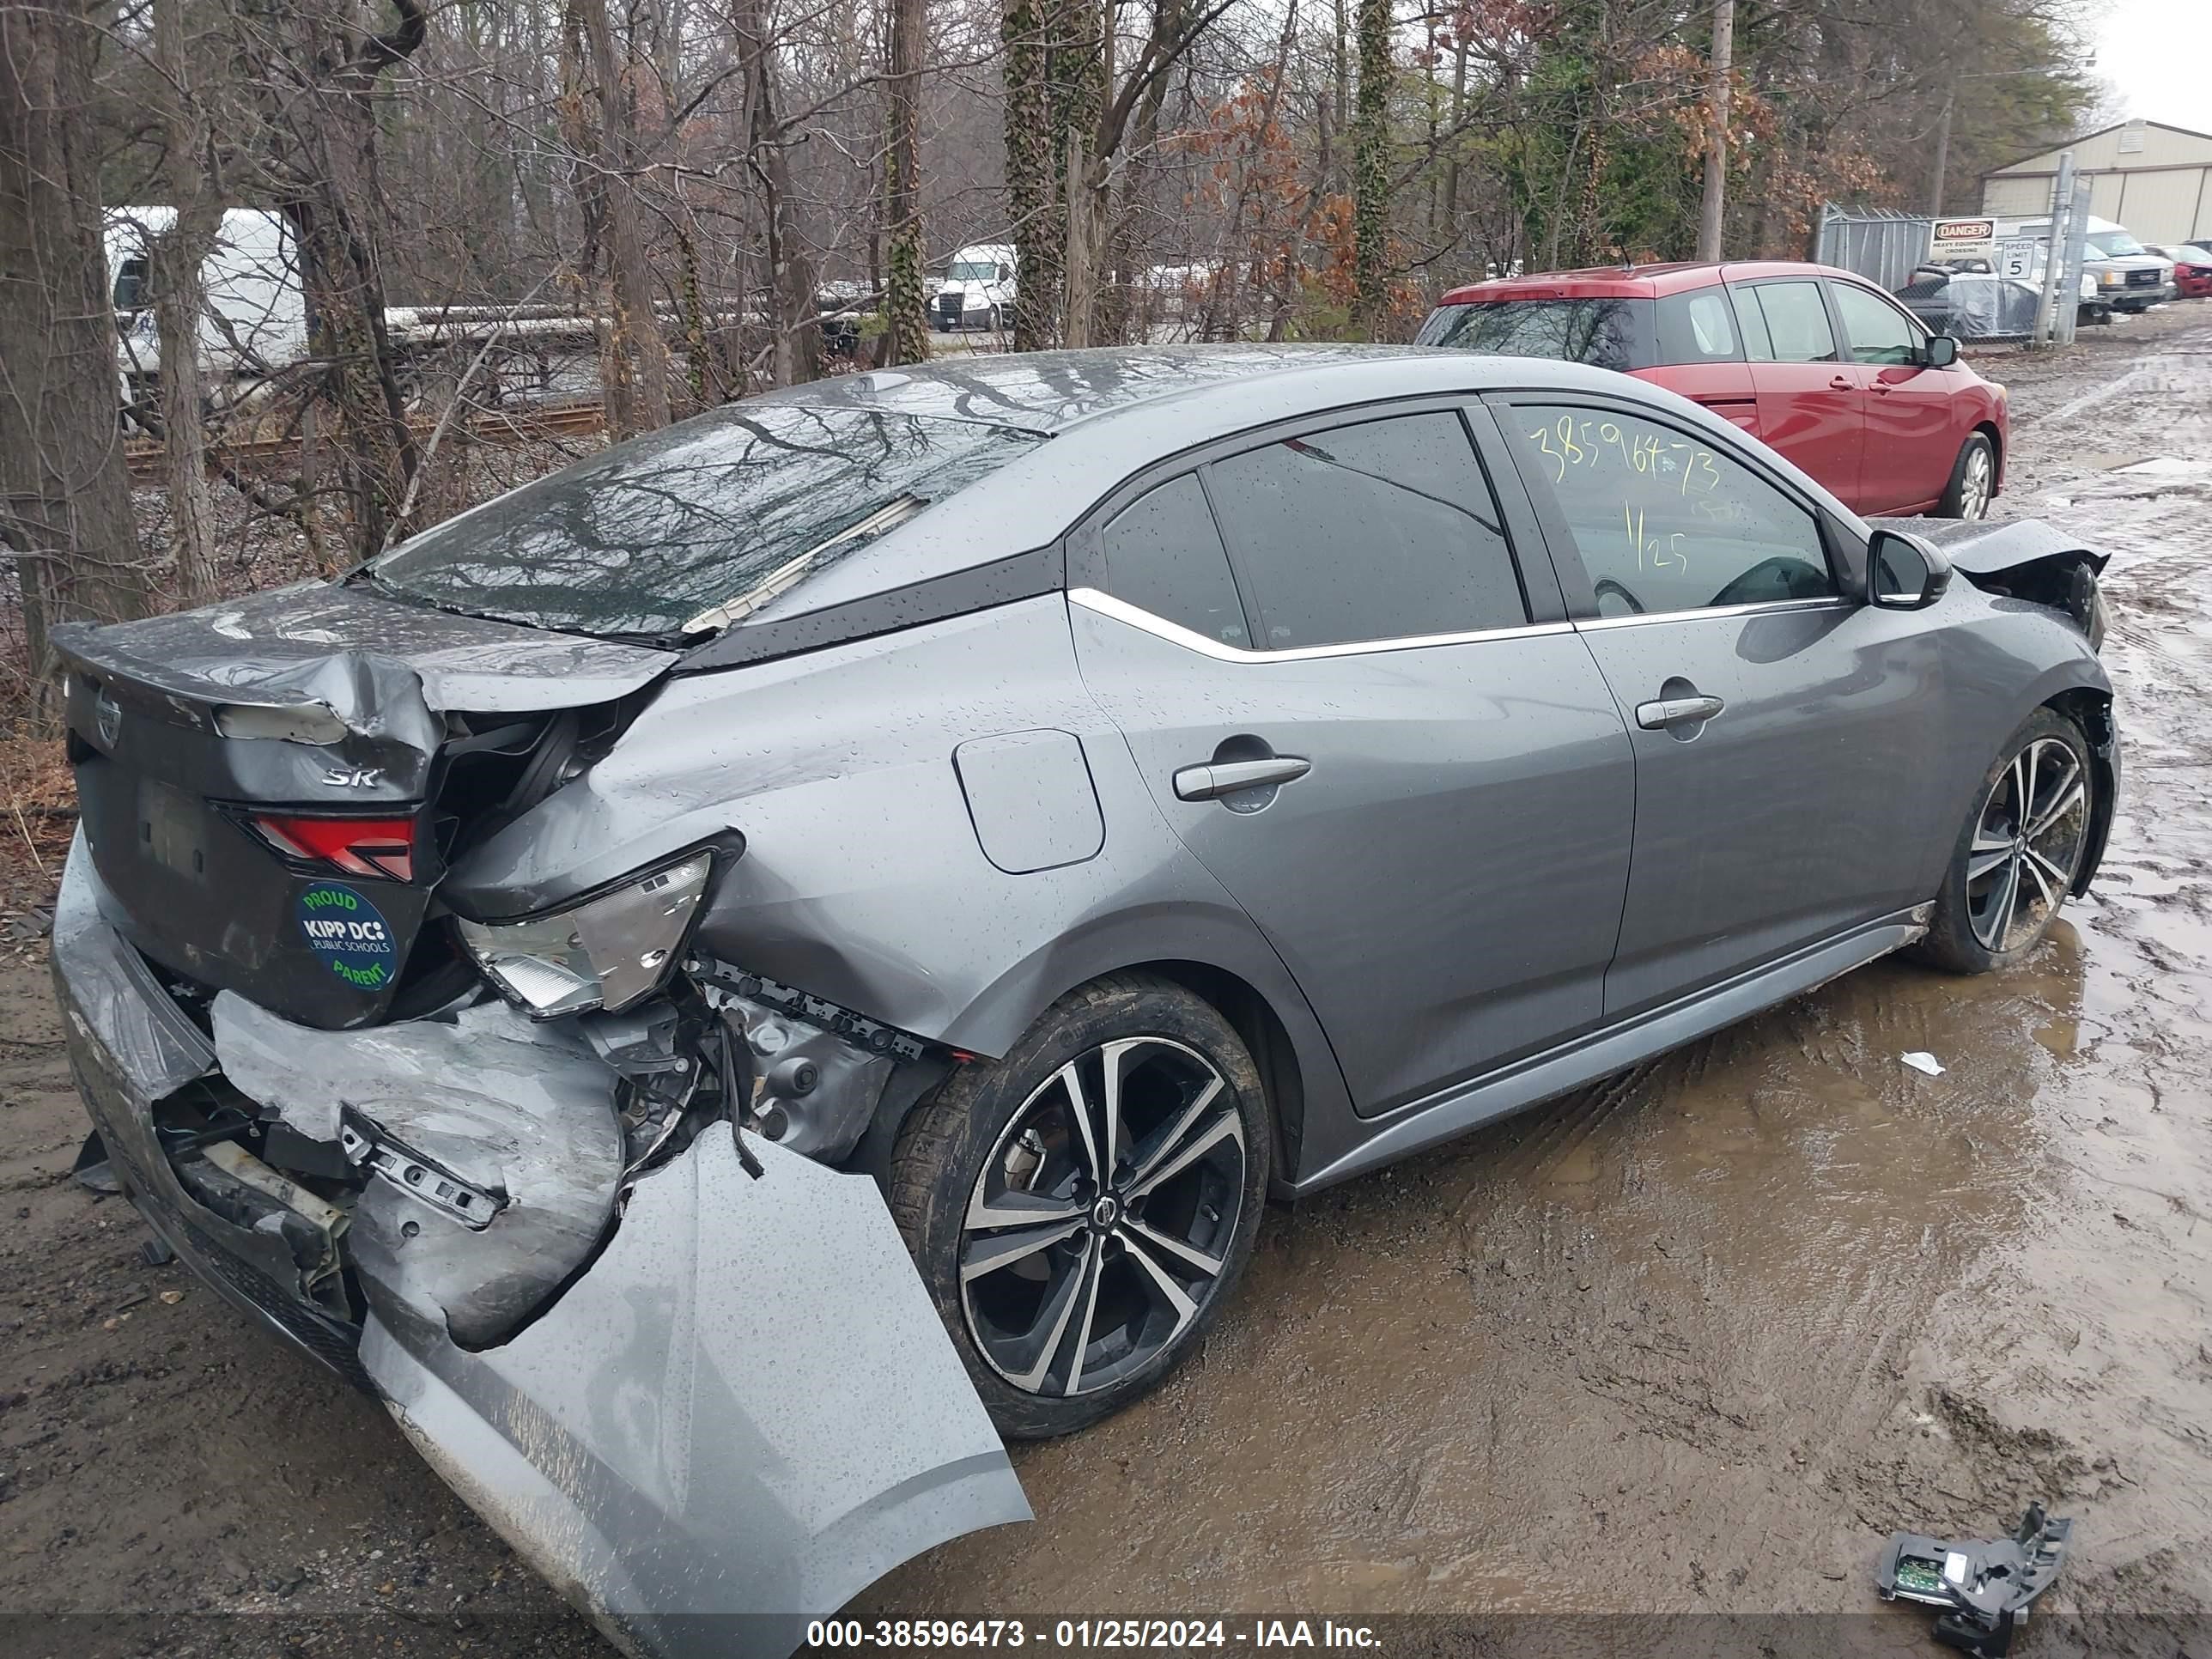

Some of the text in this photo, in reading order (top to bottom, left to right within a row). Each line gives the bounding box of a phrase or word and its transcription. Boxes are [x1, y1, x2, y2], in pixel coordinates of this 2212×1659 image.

[1941, 224, 1987, 237] DANGER
[2009, 261, 2022, 276] 5
[1529, 416, 1719, 495] 38596473
[303, 890, 358, 911] PROUD
[303, 920, 346, 939] KIPP
[313, 939, 391, 953] PUBLIC SCHOOLS
[333, 959, 386, 986] PARENT
